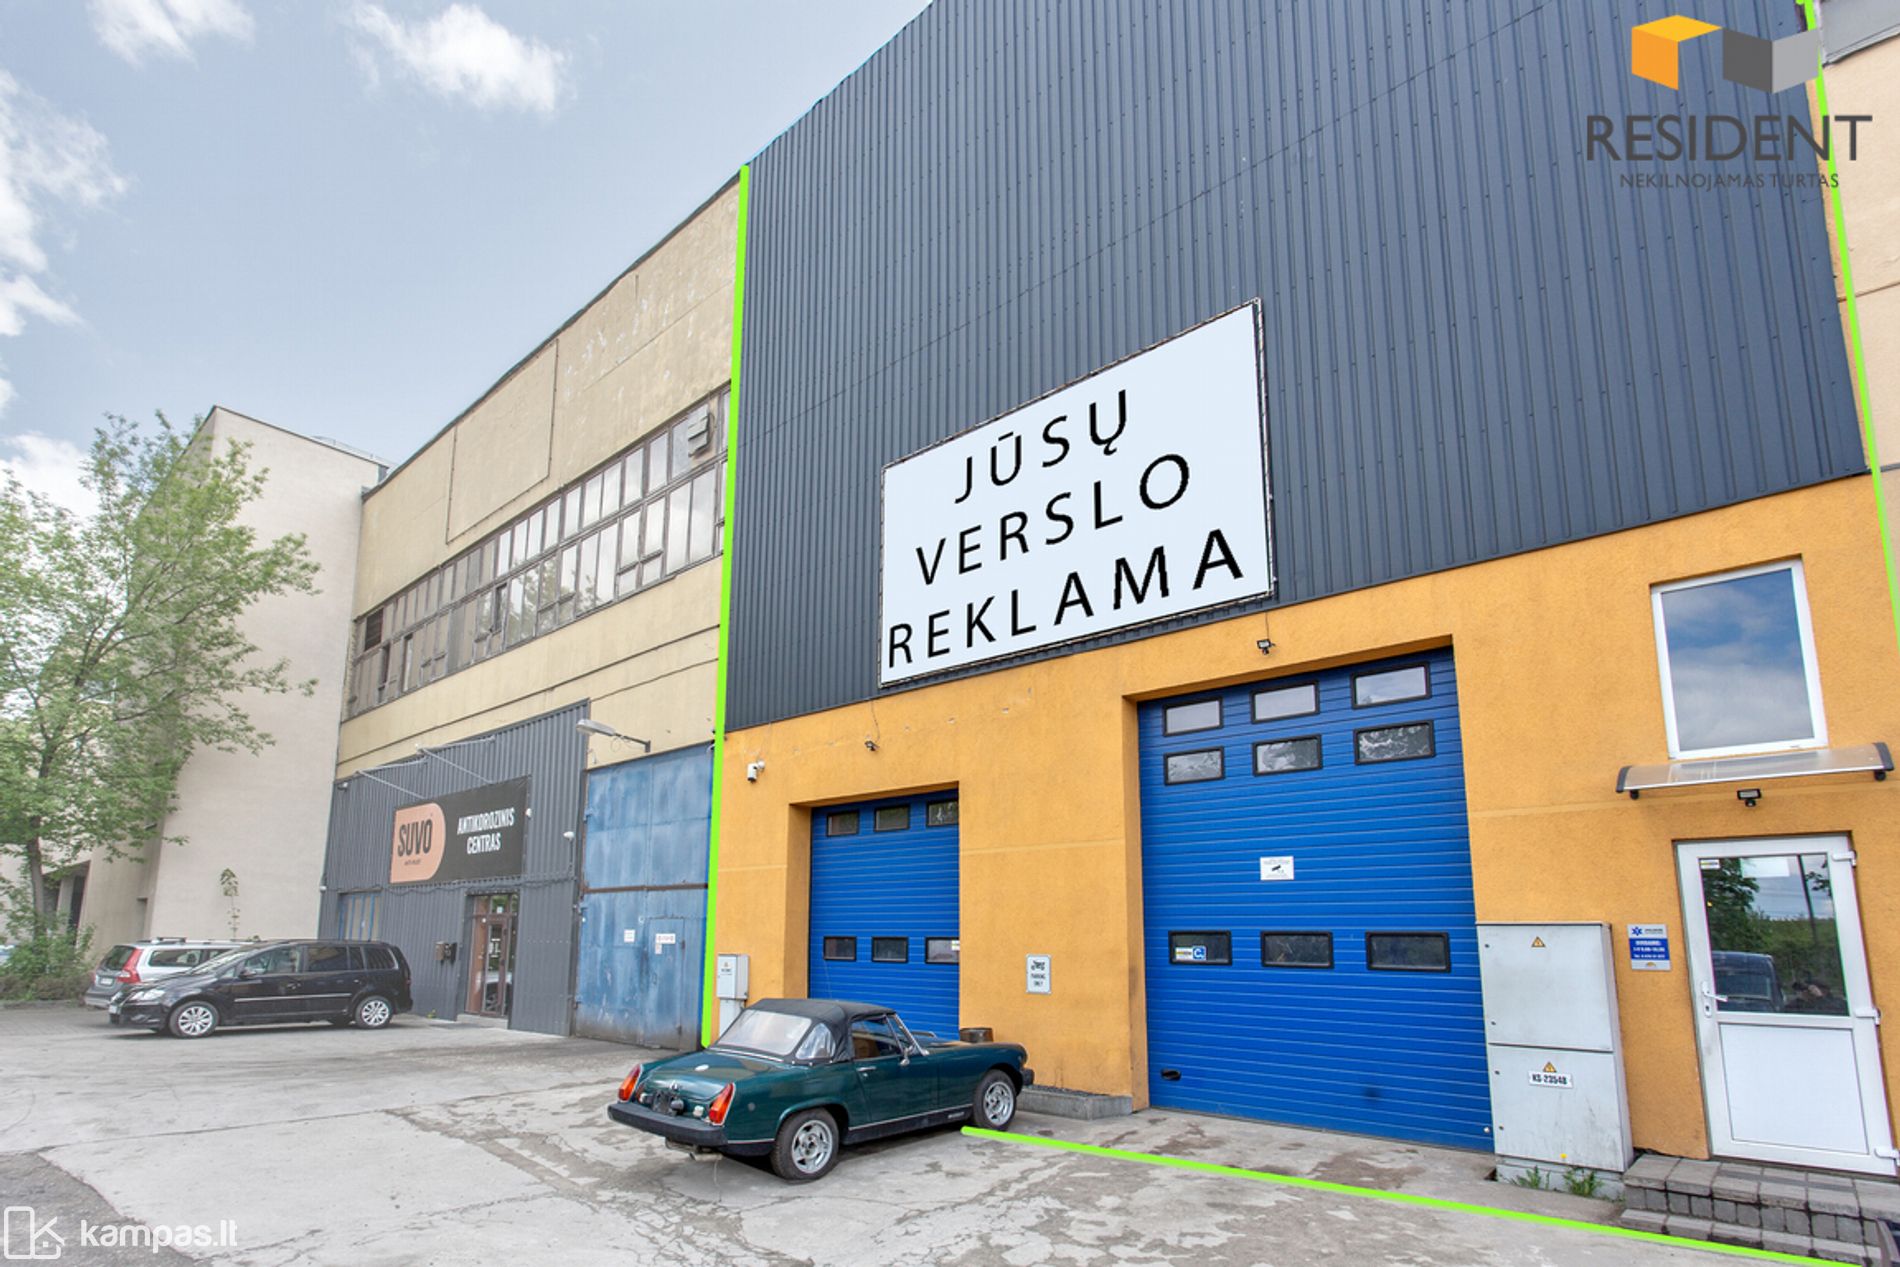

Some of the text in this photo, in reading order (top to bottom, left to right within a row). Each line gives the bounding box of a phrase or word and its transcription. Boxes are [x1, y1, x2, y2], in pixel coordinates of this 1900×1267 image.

[954, 389, 1127, 504] JŪSŲ
[915, 454, 1190, 585] VERSLO
[888, 528, 1243, 669] REKLAMA
[397, 819, 433, 857] SUVO
[466, 832, 501, 854] CENTRAS
